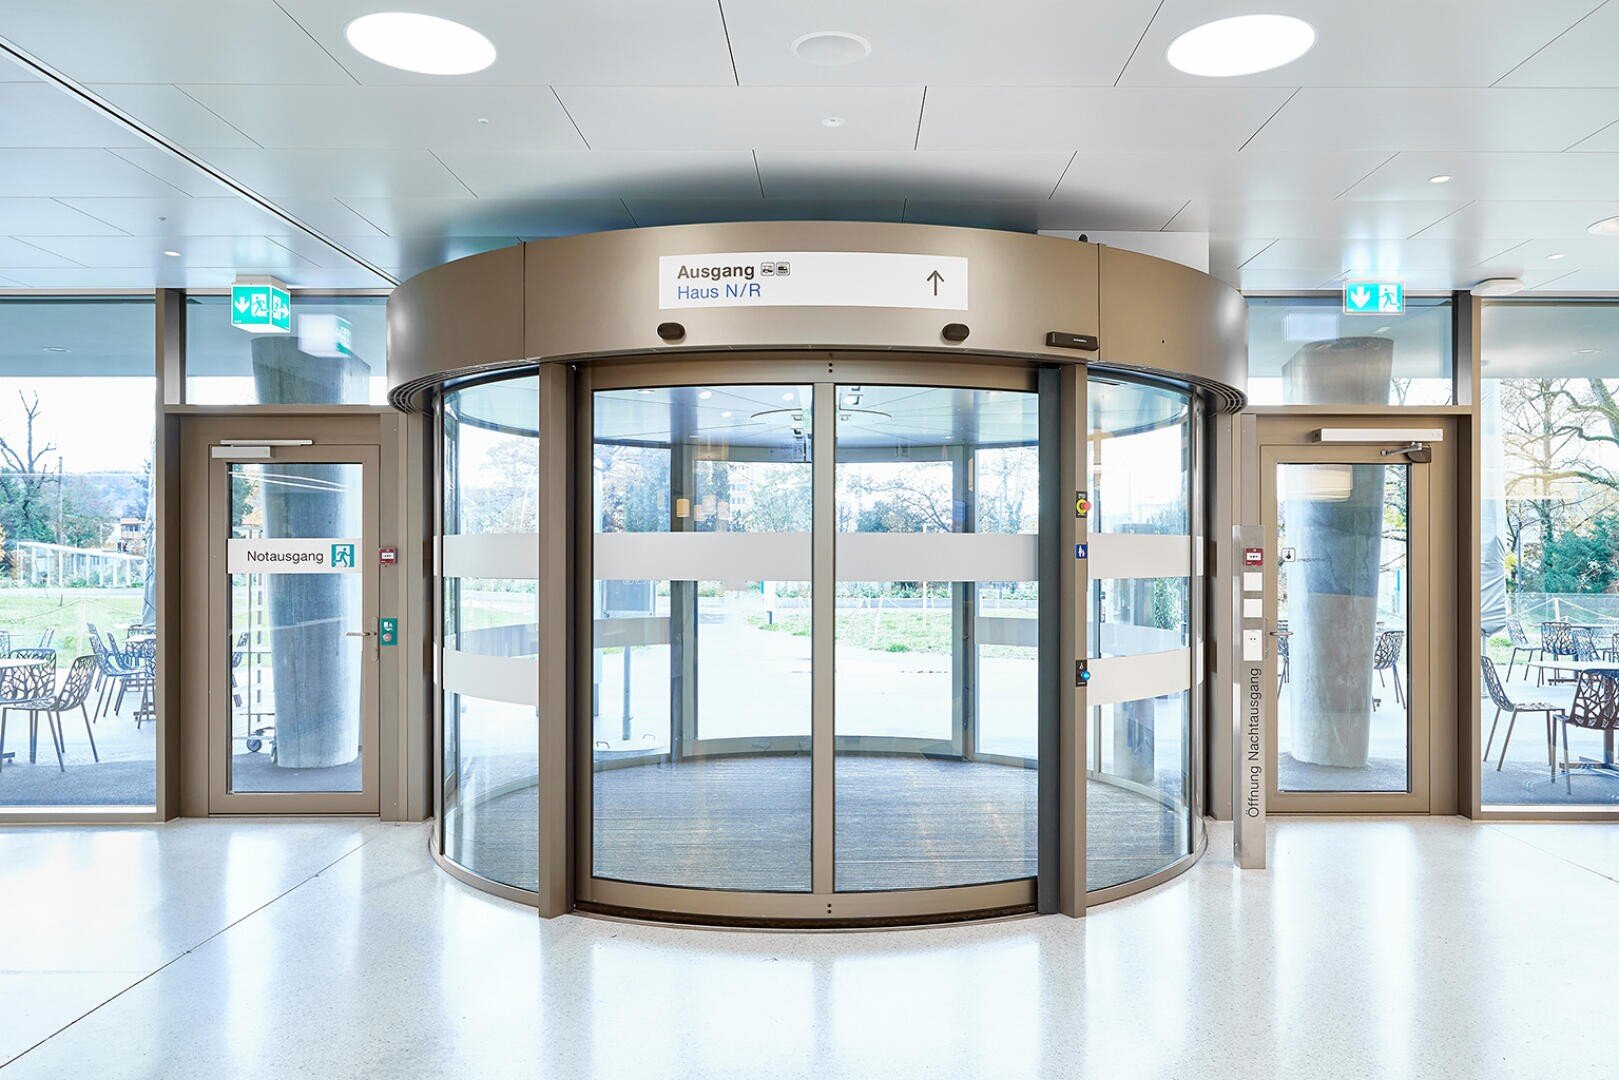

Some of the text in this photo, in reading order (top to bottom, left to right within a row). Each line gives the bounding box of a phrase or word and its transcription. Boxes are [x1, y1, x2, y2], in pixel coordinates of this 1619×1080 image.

[677, 264, 755, 282] Ausgang
[677, 282, 761, 300] Haus N/R
[247, 550, 324, 564] Notausgang
[1246, 667, 1263, 818] Öffnung Nachtausgang
